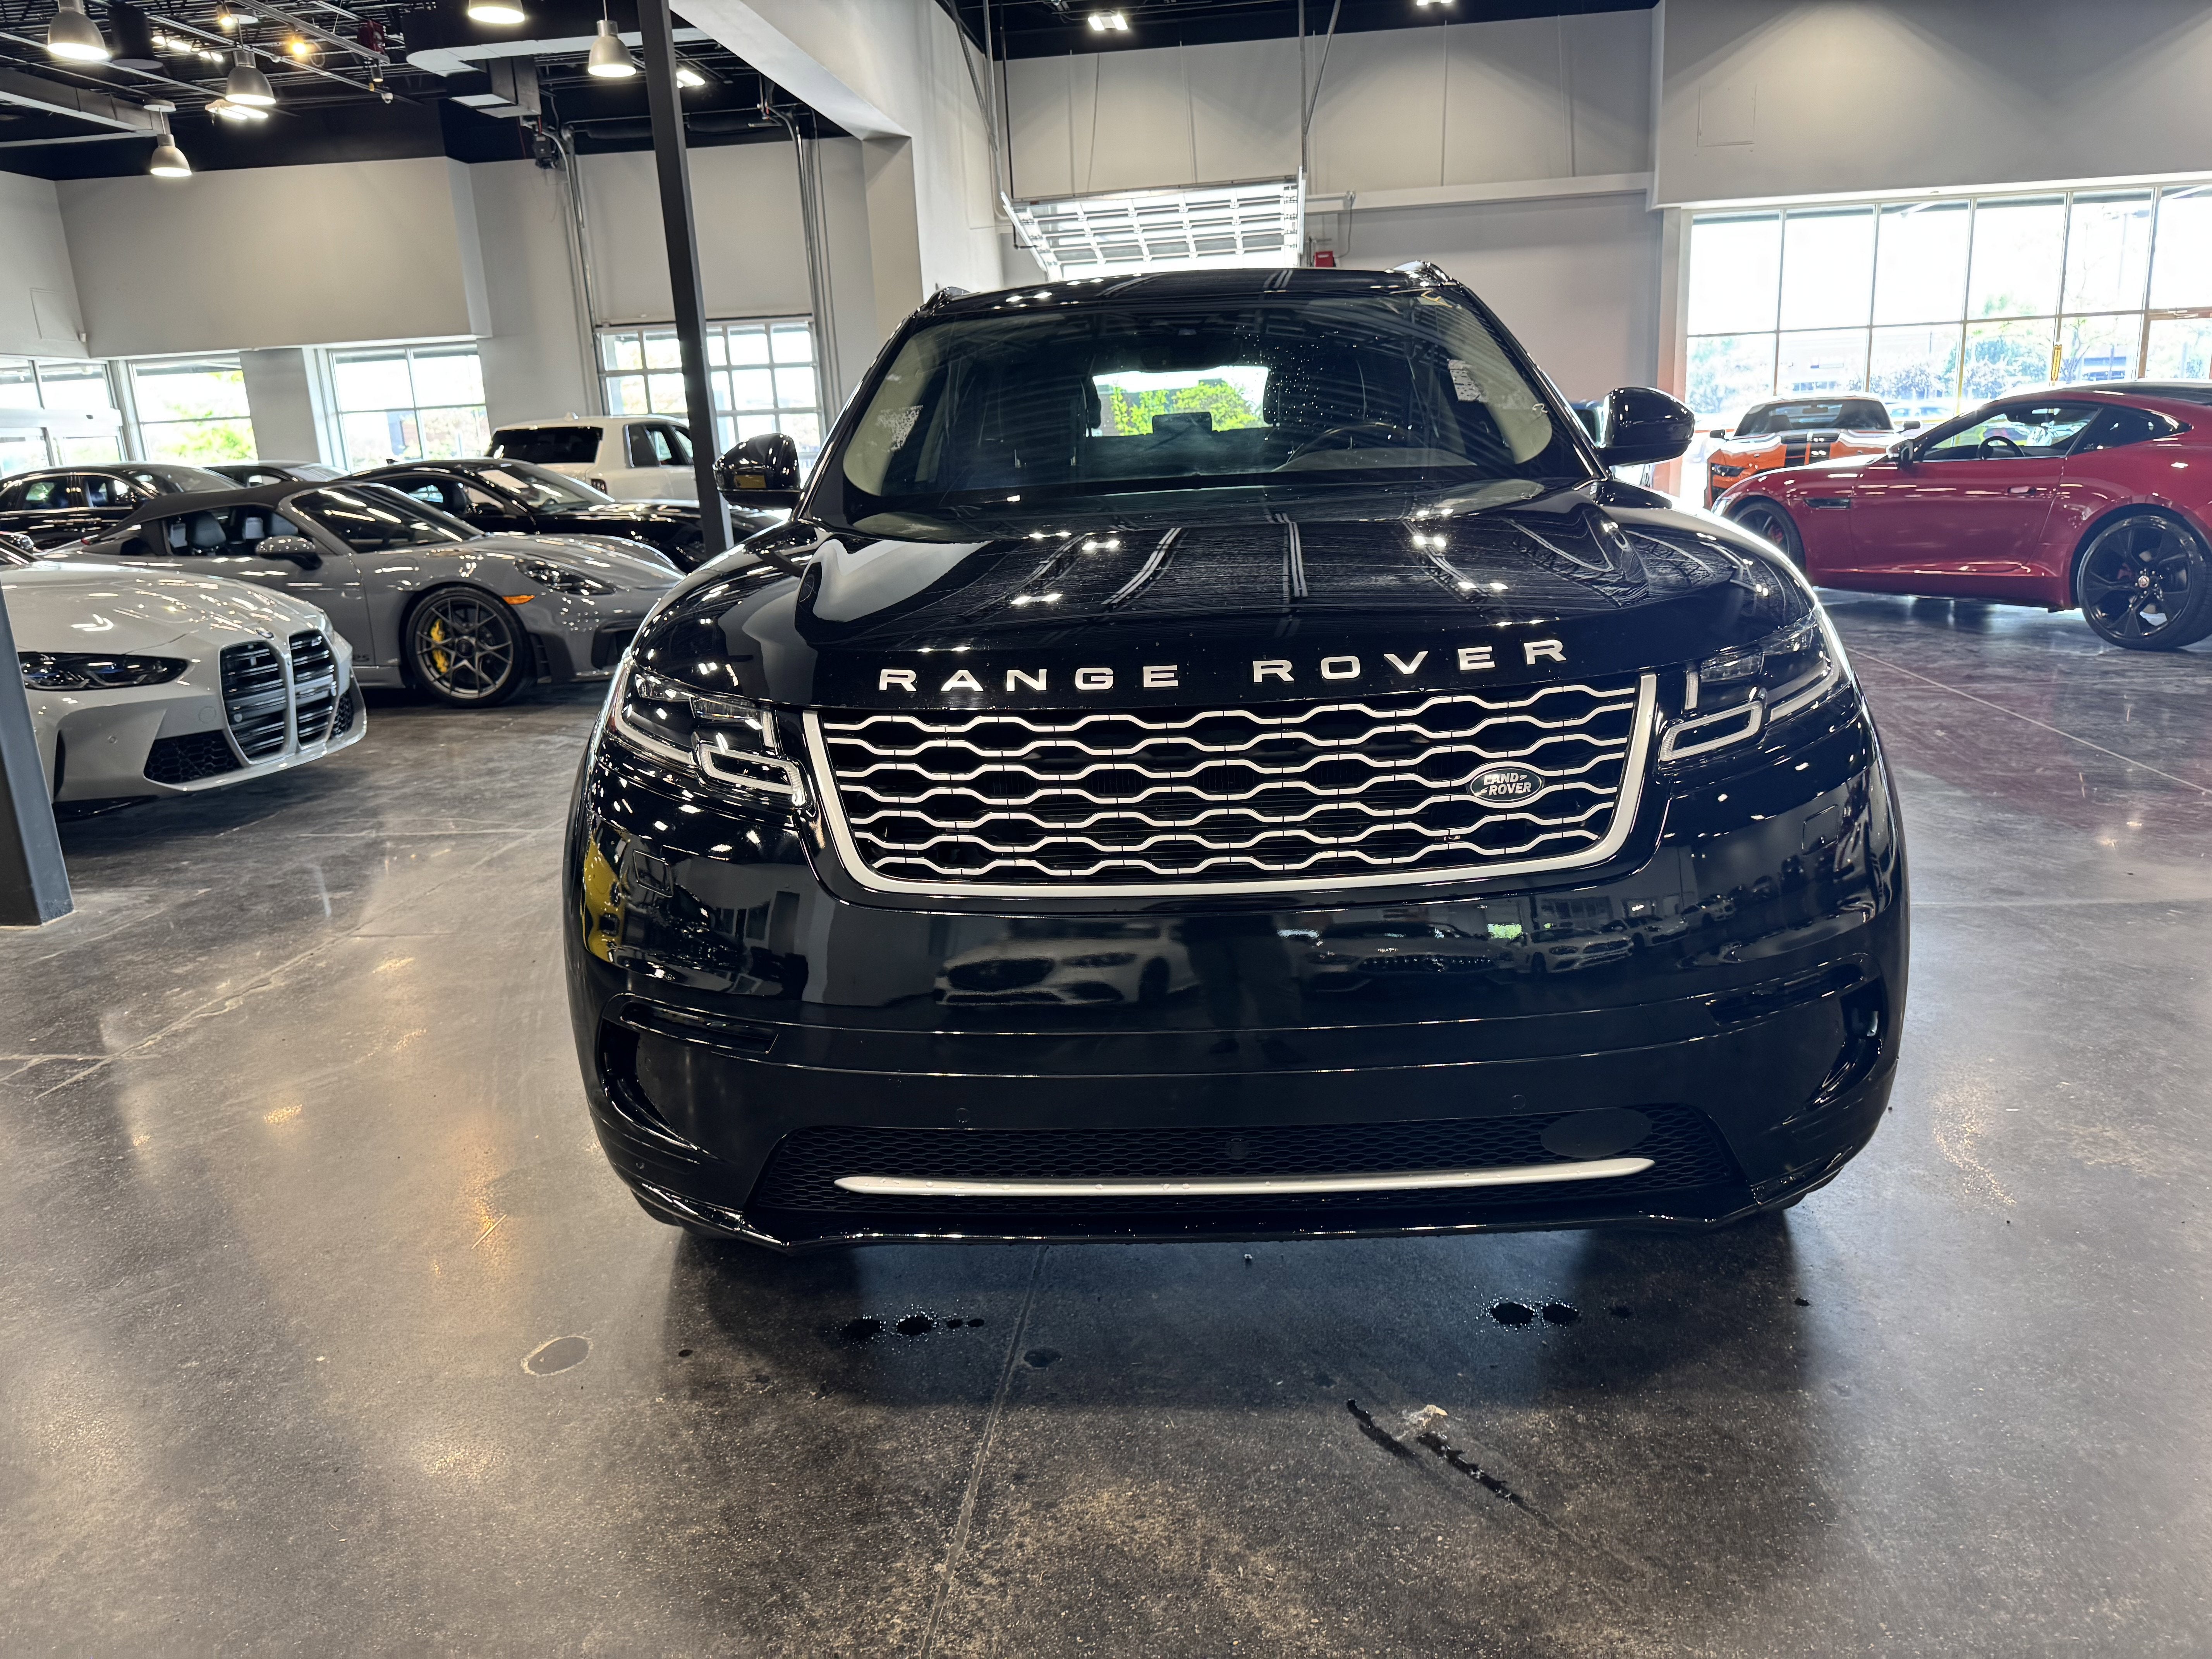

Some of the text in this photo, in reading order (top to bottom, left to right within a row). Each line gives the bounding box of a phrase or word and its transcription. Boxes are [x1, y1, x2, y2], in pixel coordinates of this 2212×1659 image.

[879, 639, 1567, 692] RANGE ROVER
[1484, 773, 1519, 785] LAND
[1488, 782, 1532, 796] ROVER
